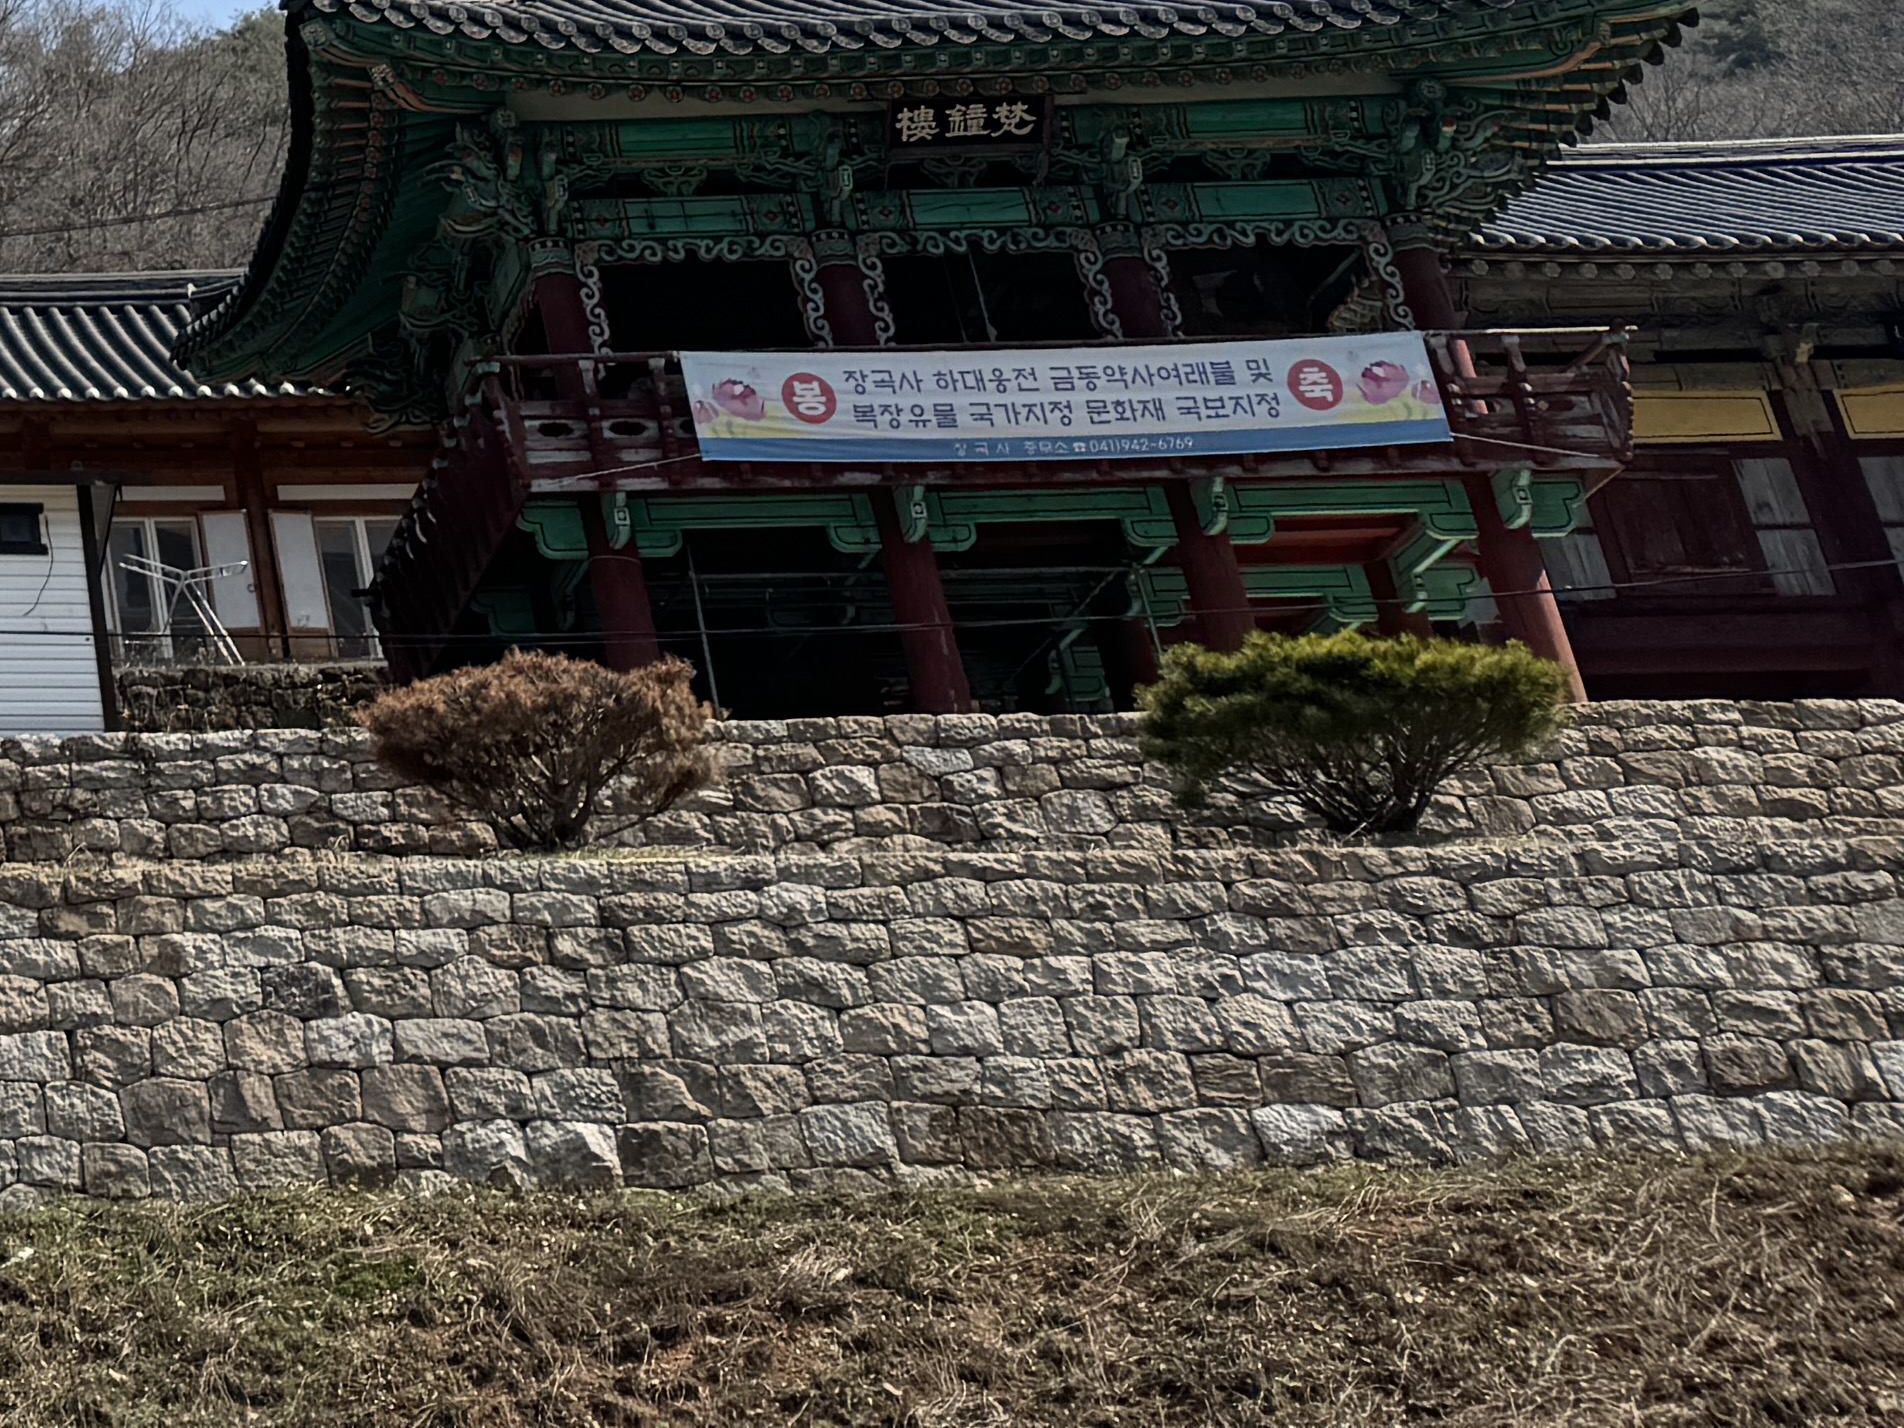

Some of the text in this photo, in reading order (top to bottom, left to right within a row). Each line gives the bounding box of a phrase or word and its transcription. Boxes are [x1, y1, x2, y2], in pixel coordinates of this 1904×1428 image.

[842, 357, 1274, 395] 장곡사 하대웅전 금동약사여래불 및
[1299, 366, 1334, 402] 축
[792, 380, 827, 416] 봉
[853, 392, 1280, 430] 복장유물 국가지정 문화재 국보지정
